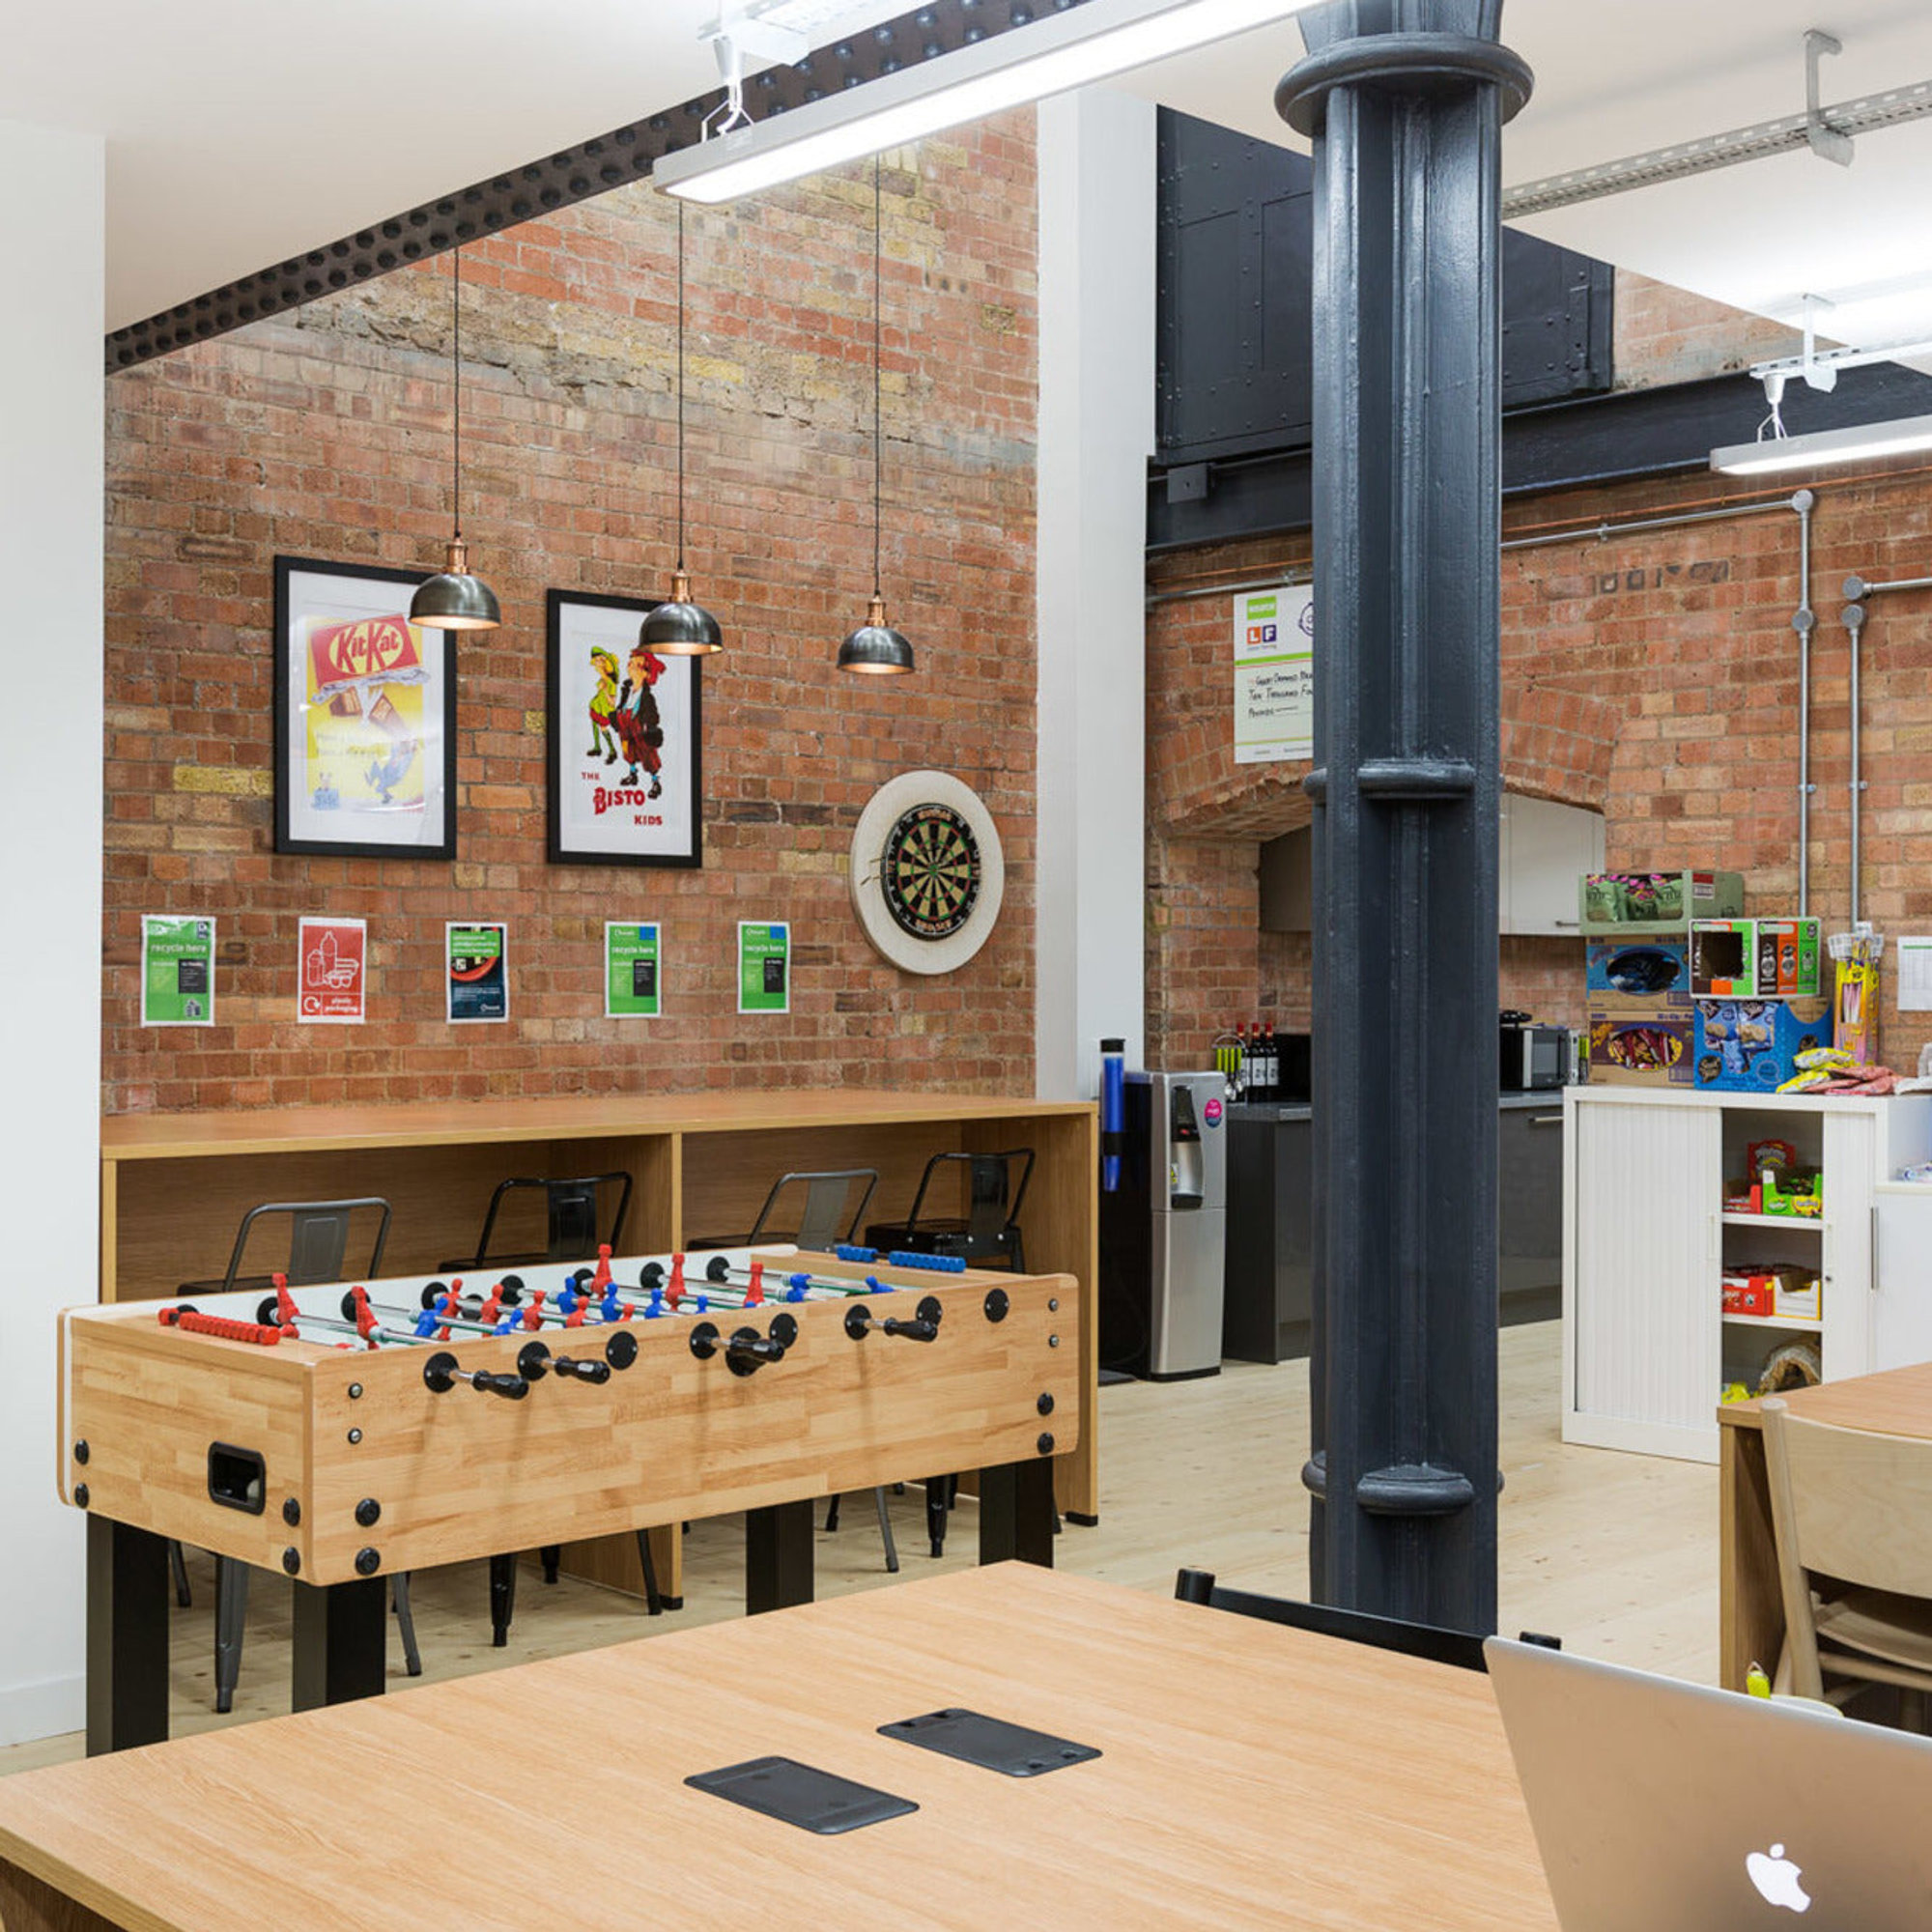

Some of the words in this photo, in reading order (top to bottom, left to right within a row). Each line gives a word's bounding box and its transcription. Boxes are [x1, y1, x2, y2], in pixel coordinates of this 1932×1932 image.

[581, 771, 600, 781] THE
[592, 786, 646, 816] BISTO
[634, 814, 664, 826] KIDS
[151, 944, 185, 954] recycle
[185, 943, 207, 952] here
